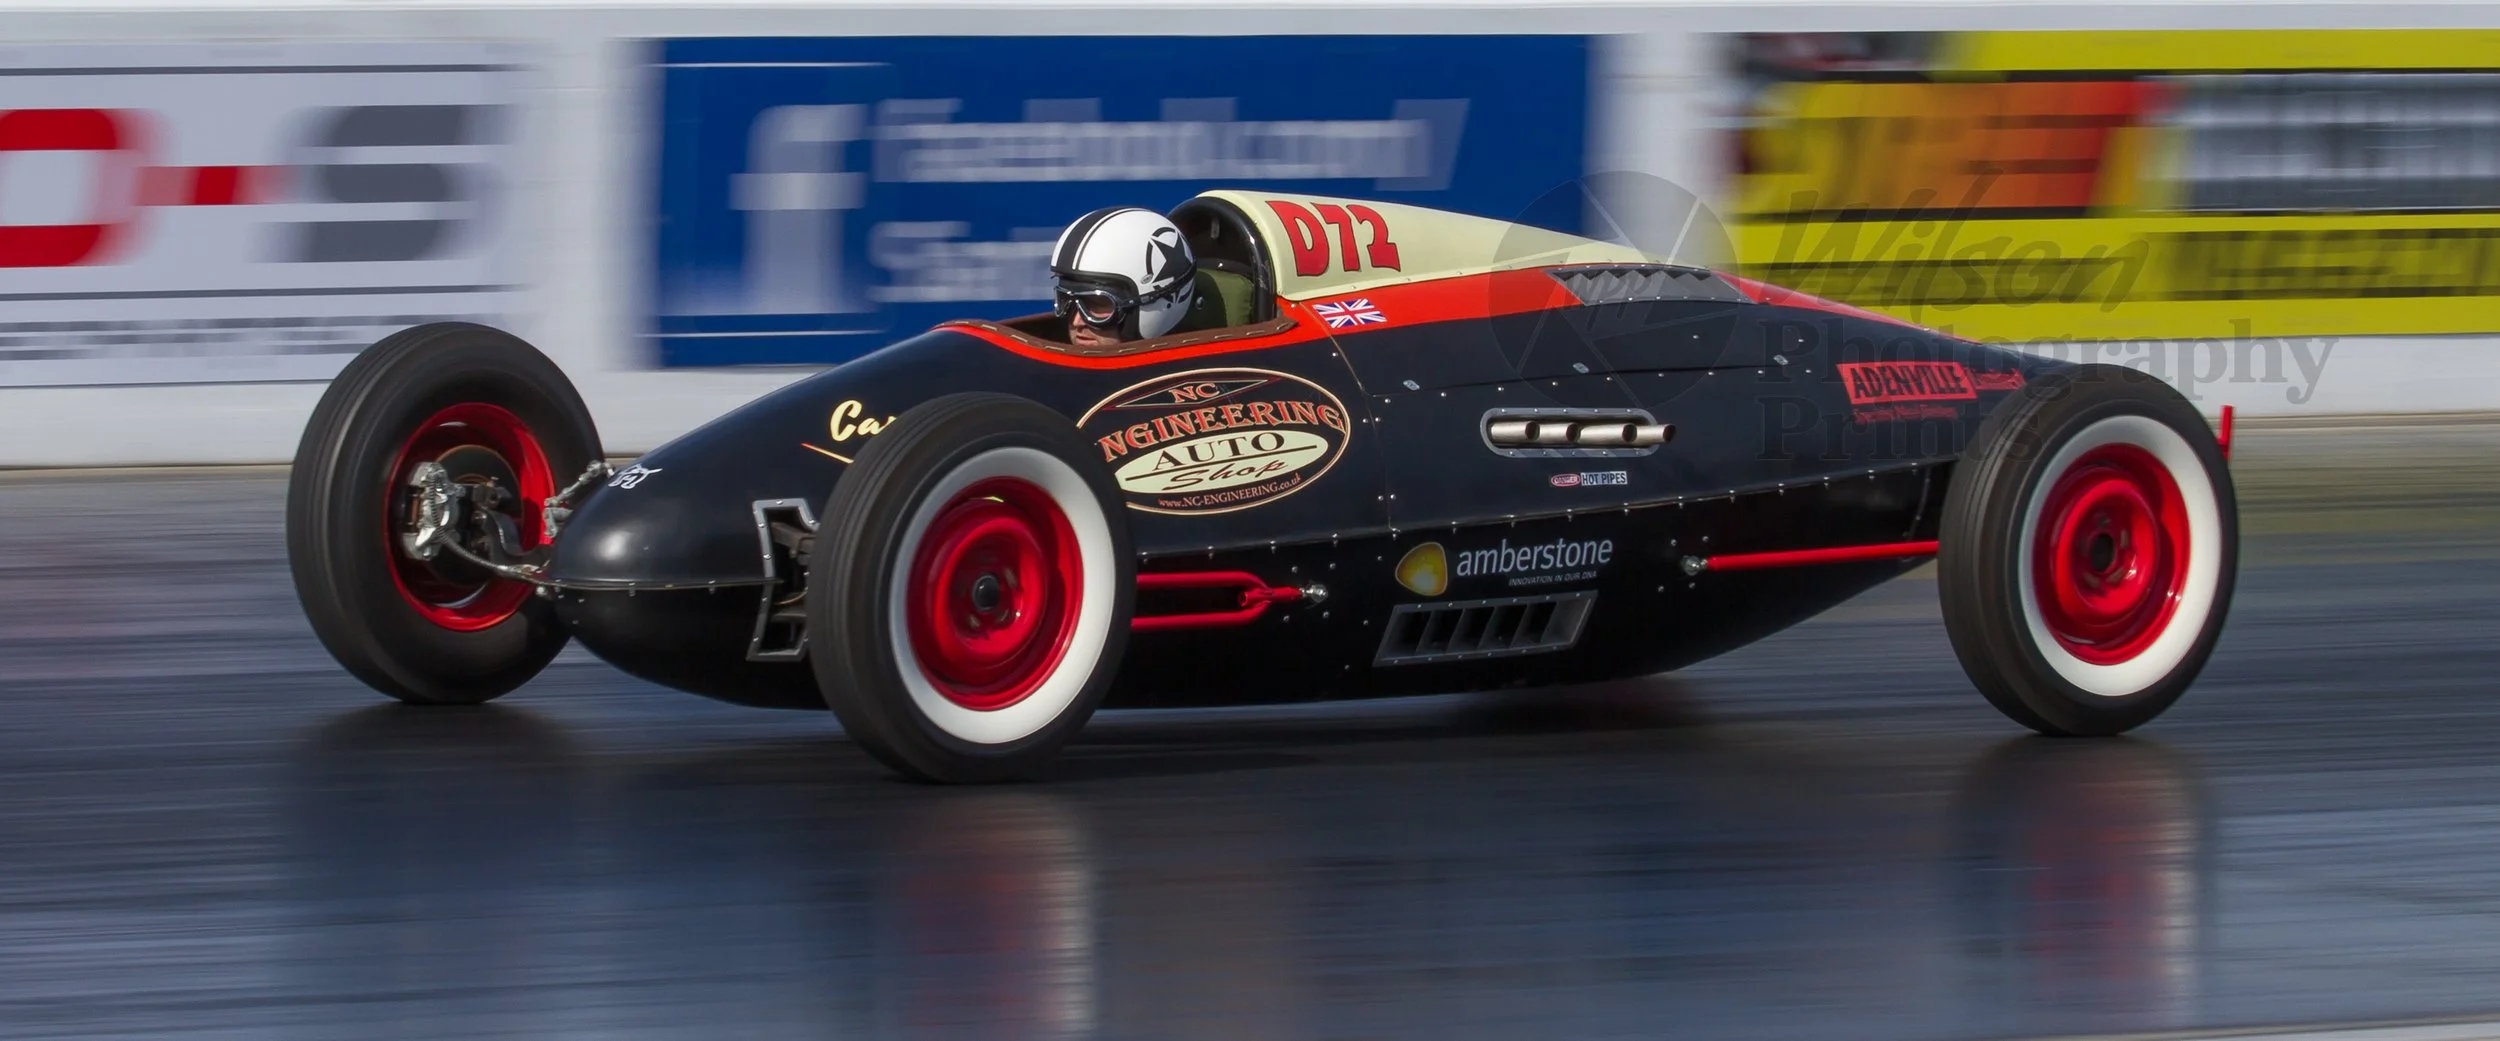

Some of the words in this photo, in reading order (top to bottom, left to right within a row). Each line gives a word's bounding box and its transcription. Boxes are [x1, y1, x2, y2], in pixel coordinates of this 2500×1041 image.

[1265, 200, 1401, 277] D72
[1168, 383, 1220, 403] NC
[1851, 366, 1968, 398] ADENVILLE
[830, 399, 898, 441] Ca
[1094, 401, 1346, 463] NGINEERING
[1151, 431, 1286, 472] AUTO
[1157, 472, 1302, 508] www.NC-ENGINEERING.co.uk
[1162, 458, 1290, 491] Shop
[1457, 538, 1614, 577] amberstone
